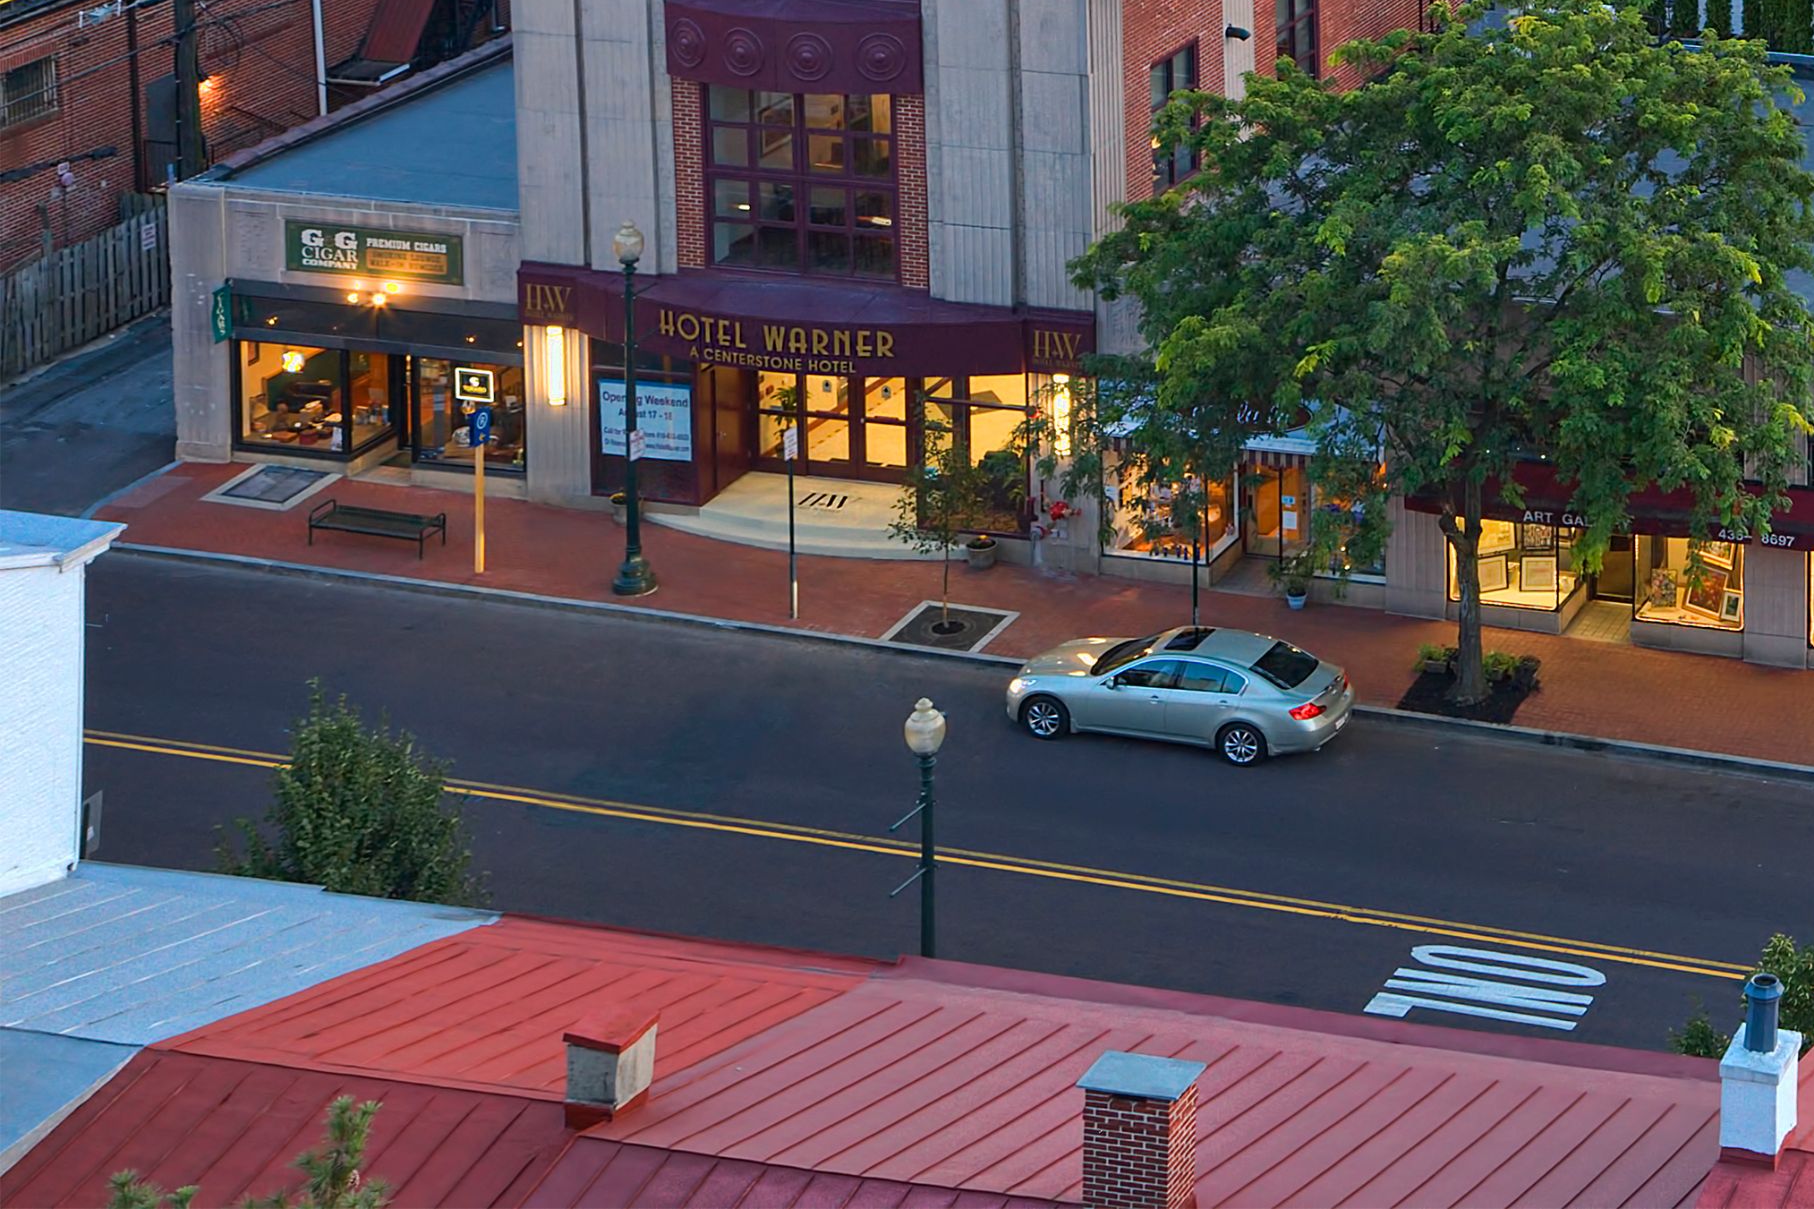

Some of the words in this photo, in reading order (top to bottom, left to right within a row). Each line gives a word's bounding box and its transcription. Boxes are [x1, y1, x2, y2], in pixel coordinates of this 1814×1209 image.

[366, 237, 411, 251] PREMIUM
[414, 242, 447, 254] CIGARS
[301, 246, 358, 263] CIGAR
[302, 258, 358, 270] COMPANY
[659, 309, 747, 348] HOTEL
[763, 324, 895, 358] WARNER
[689, 345, 699, 358] A
[703, 348, 802, 371] CENTERSTONE
[808, 359, 856, 374] HOTEL
[602, 391, 643, 406] Openg
[644, 395, 688, 407] Weekend
[1523, 510, 1553, 523] ART
[1761, 532, 1795, 547] 8697
